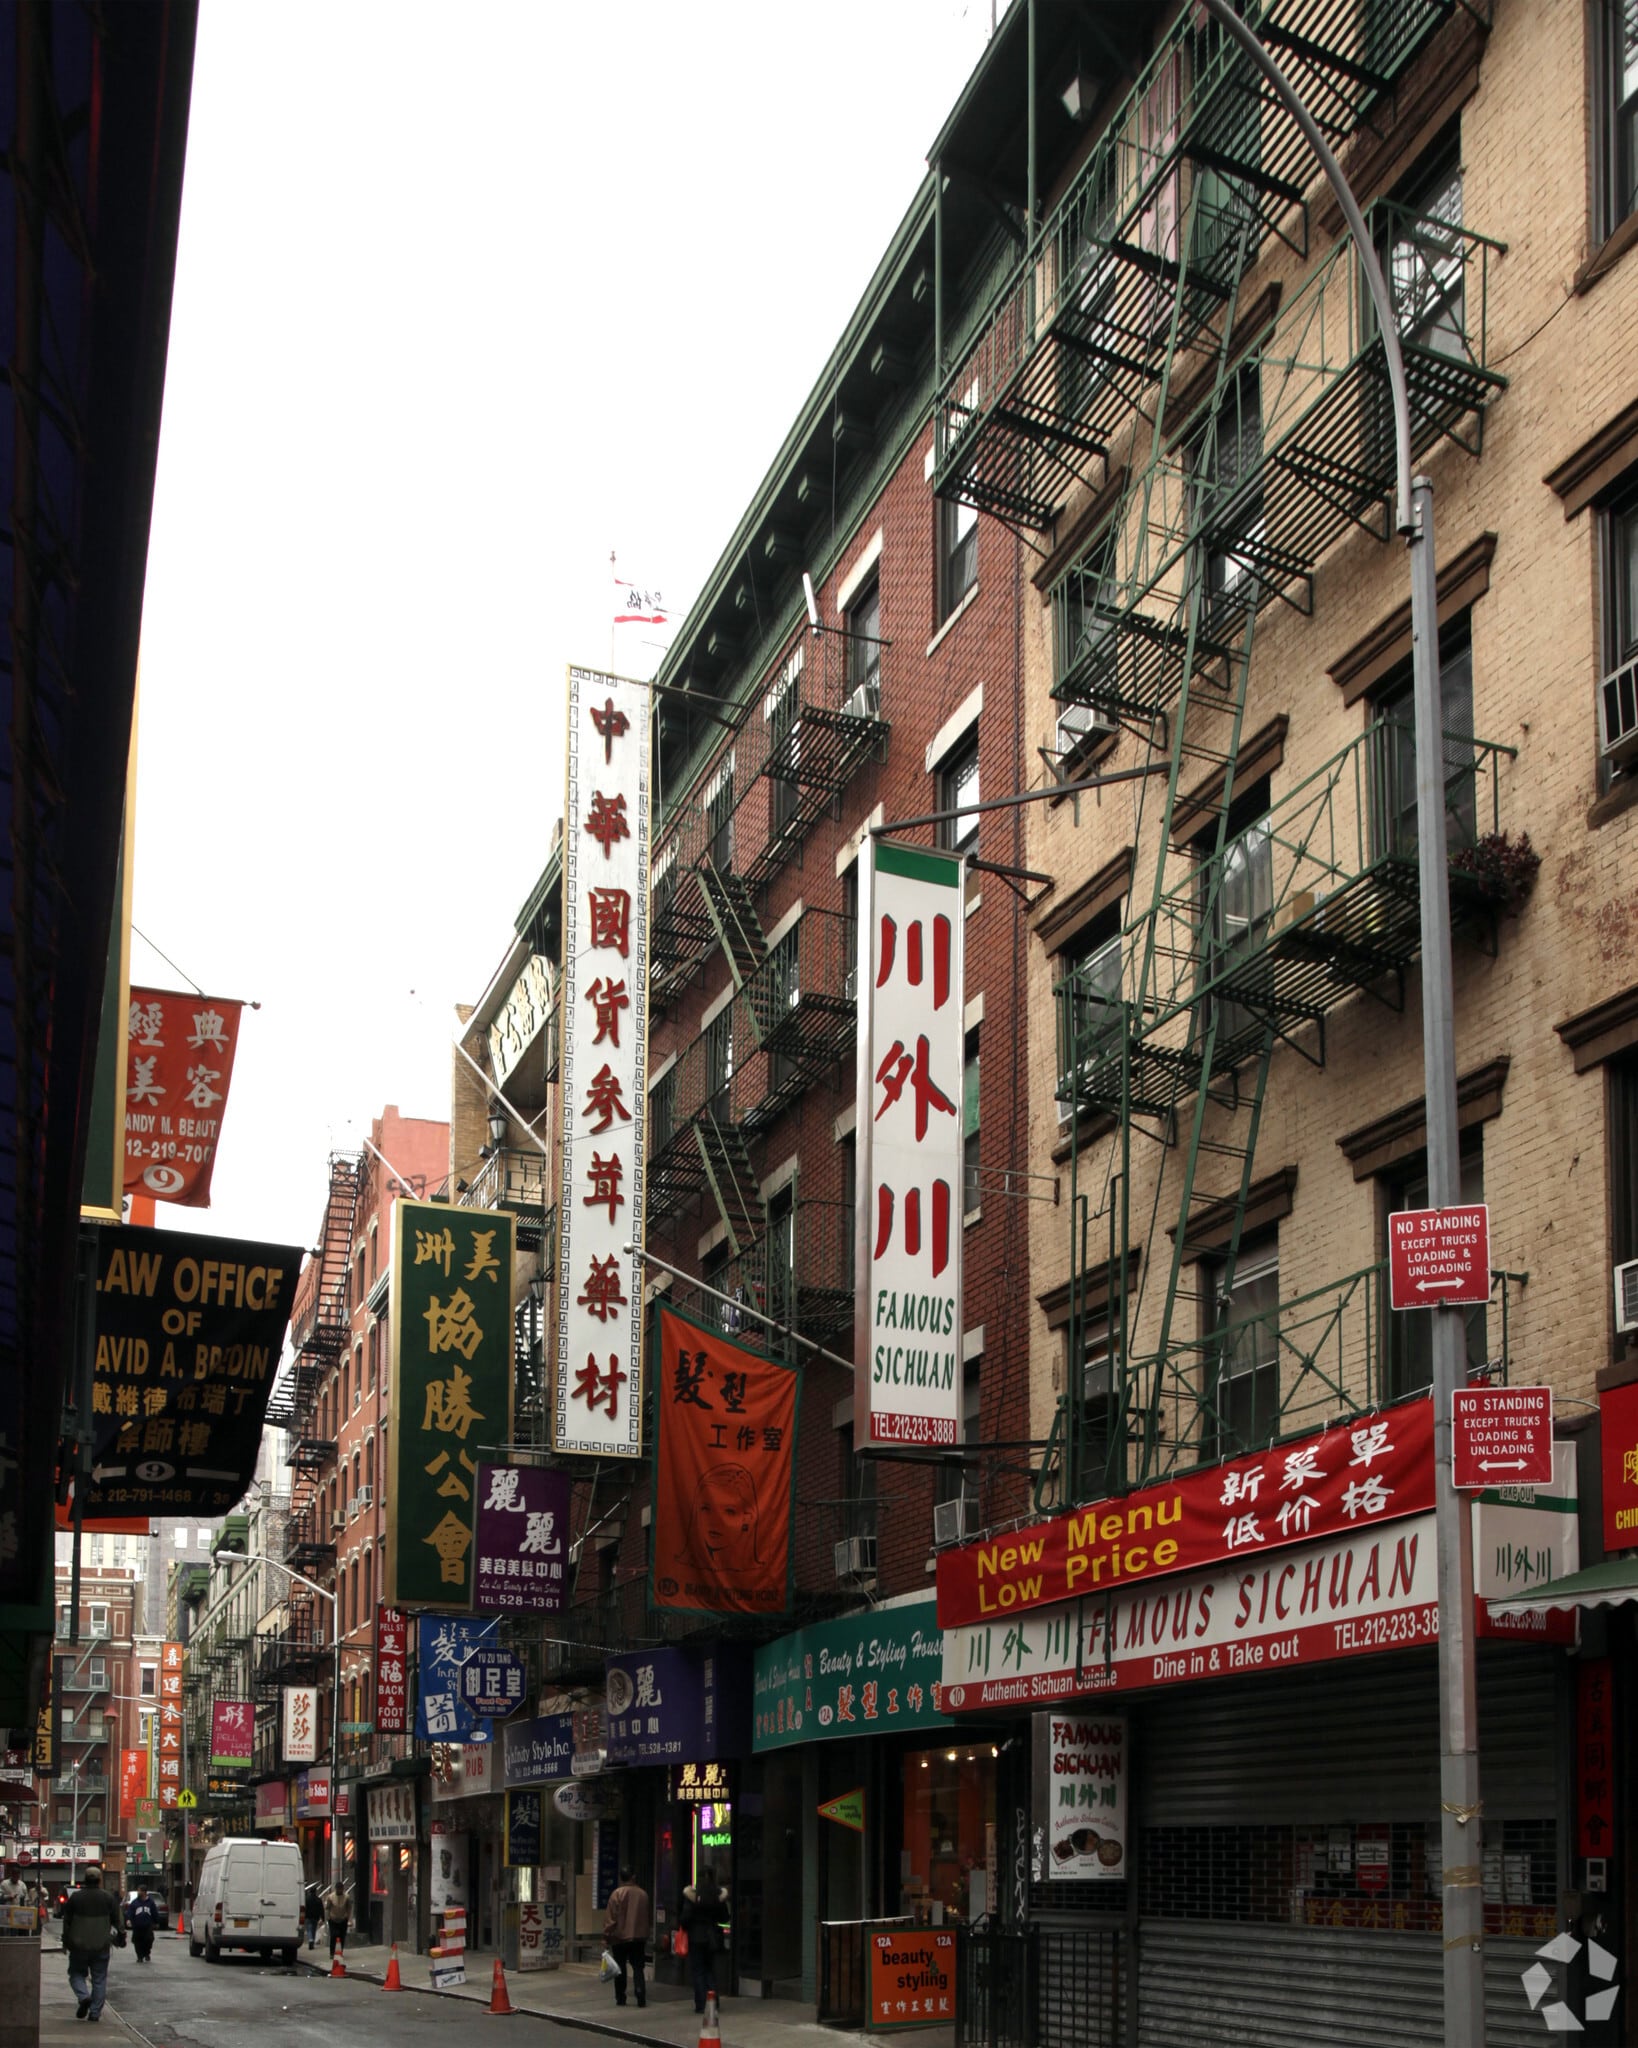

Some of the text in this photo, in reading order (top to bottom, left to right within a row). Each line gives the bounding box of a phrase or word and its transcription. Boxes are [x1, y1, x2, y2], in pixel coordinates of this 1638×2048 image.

[126, 1055, 222, 1109] 美容
[874, 912, 957, 1280] 川外川
[126, 1113, 217, 1138] ANDY M. BEAUT
[1397, 1215, 1480, 1234] NO STANDING
[1401, 1234, 1478, 1250] EXCEPT TRUCKS
[1407, 1248, 1471, 1263] LOADING &
[1409, 1262, 1472, 1277] UNLOADING
[172, 1256, 284, 1312] OFFICE
[161, 1307, 203, 1337] OF
[876, 1290, 954, 1336] FAMOUS
[94, 1335, 151, 1376] AVID
[159, 1340, 184, 1379] A.
[873, 1345, 955, 1391] SICHUAN
[674, 1348, 747, 1414] 髮型
[1460, 1397, 1544, 1412] NO STANDING
[421, 1287, 486, 1585] 協勝公會
[873, 1413, 955, 1445] TEL:212-233-3888
[1464, 1416, 1540, 1428] EXCEPT TRUCKS
[1470, 1430, 1534, 1442] LOADING &
[708, 1424, 782, 1452] 工作室
[1470, 1443, 1534, 1456] UNLOADING
[1219, 1421, 1395, 1506] 新菜單
[483, 1468, 562, 1555] 麗麗
[1222, 1474, 1395, 1550] 低价格
[977, 1495, 1182, 1579] New Menu
[480, 1557, 562, 1580] 美容美髮中心
[978, 1537, 1179, 1613] Low Price
[1496, 1543, 1551, 1583] 川外川
[1088, 1533, 1419, 1657] FAMOUS SICHUAN
[380, 1623, 394, 1632] PELL
[384, 1608, 401, 1623] 16
[1334, 1607, 1439, 1651] TEL:212-233-38
[968, 1610, 1072, 1676] 川外川
[1153, 1634, 1299, 1680] Dine in & Take out
[820, 1647, 852, 1677] Beauty
[856, 1641, 864, 1668] &
[867, 1638, 907, 1672] Styling
[378, 1684, 404, 1695] BACK
[387, 1696, 395, 1706] &
[981, 1677, 1028, 1702] Authentic
[1031, 1673, 1073, 1696] Sichuan
[378, 1706, 404, 1717] FOOT
[381, 1718, 400, 1729] RUB
[532, 1740, 552, 1760] Style
[1053, 1722, 1122, 1750] FAMOUS
[1053, 1752, 1121, 1780] SICHUAN
[1059, 1784, 1117, 1808] 川外川
[876, 1935, 951, 1947] 12A 12A
[881, 1949, 933, 1966] beauty
[896, 1969, 948, 1990] styling
